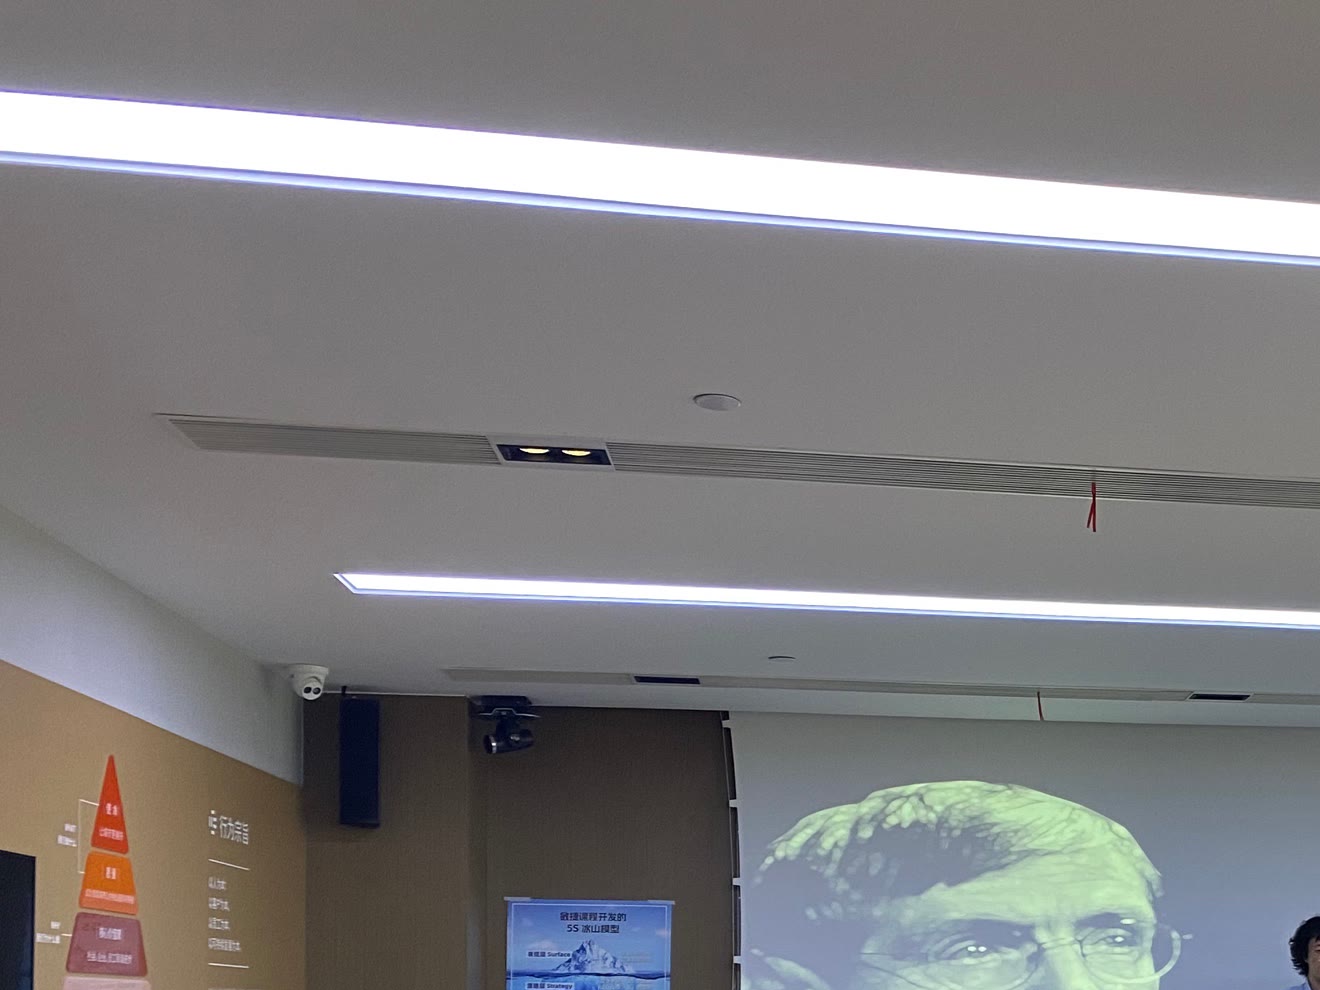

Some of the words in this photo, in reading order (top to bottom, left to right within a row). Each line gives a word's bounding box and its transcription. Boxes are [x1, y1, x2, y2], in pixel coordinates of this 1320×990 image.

[560, 912, 627, 922] 敏捷课程开发的
[567, 924, 579, 933] 5S
[581, 924, 620, 934] 冰山模型
